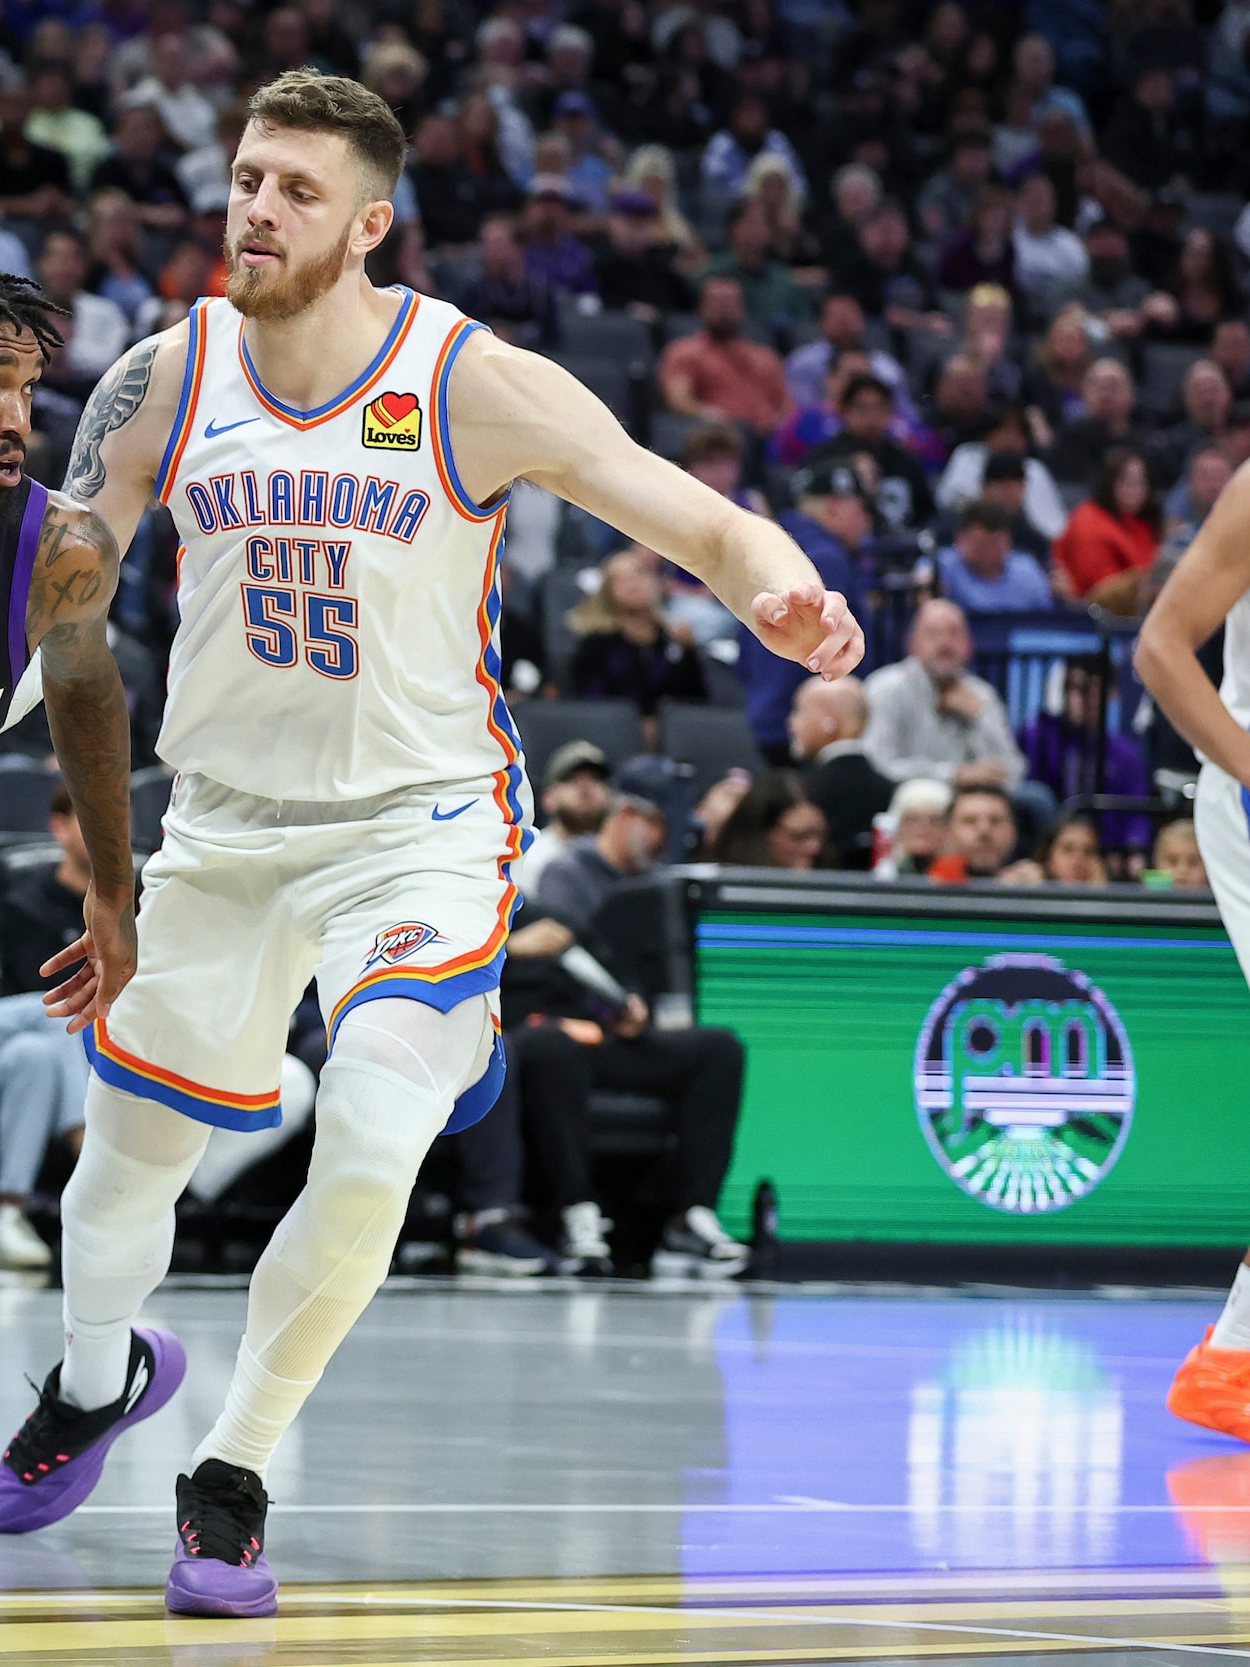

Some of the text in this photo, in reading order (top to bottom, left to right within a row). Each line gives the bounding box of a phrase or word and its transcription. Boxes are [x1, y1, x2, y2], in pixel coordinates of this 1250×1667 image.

[186, 470, 431, 544] OKLAHOMA
[246, 536, 352, 589] CITY
[240, 583, 359, 681] 55
